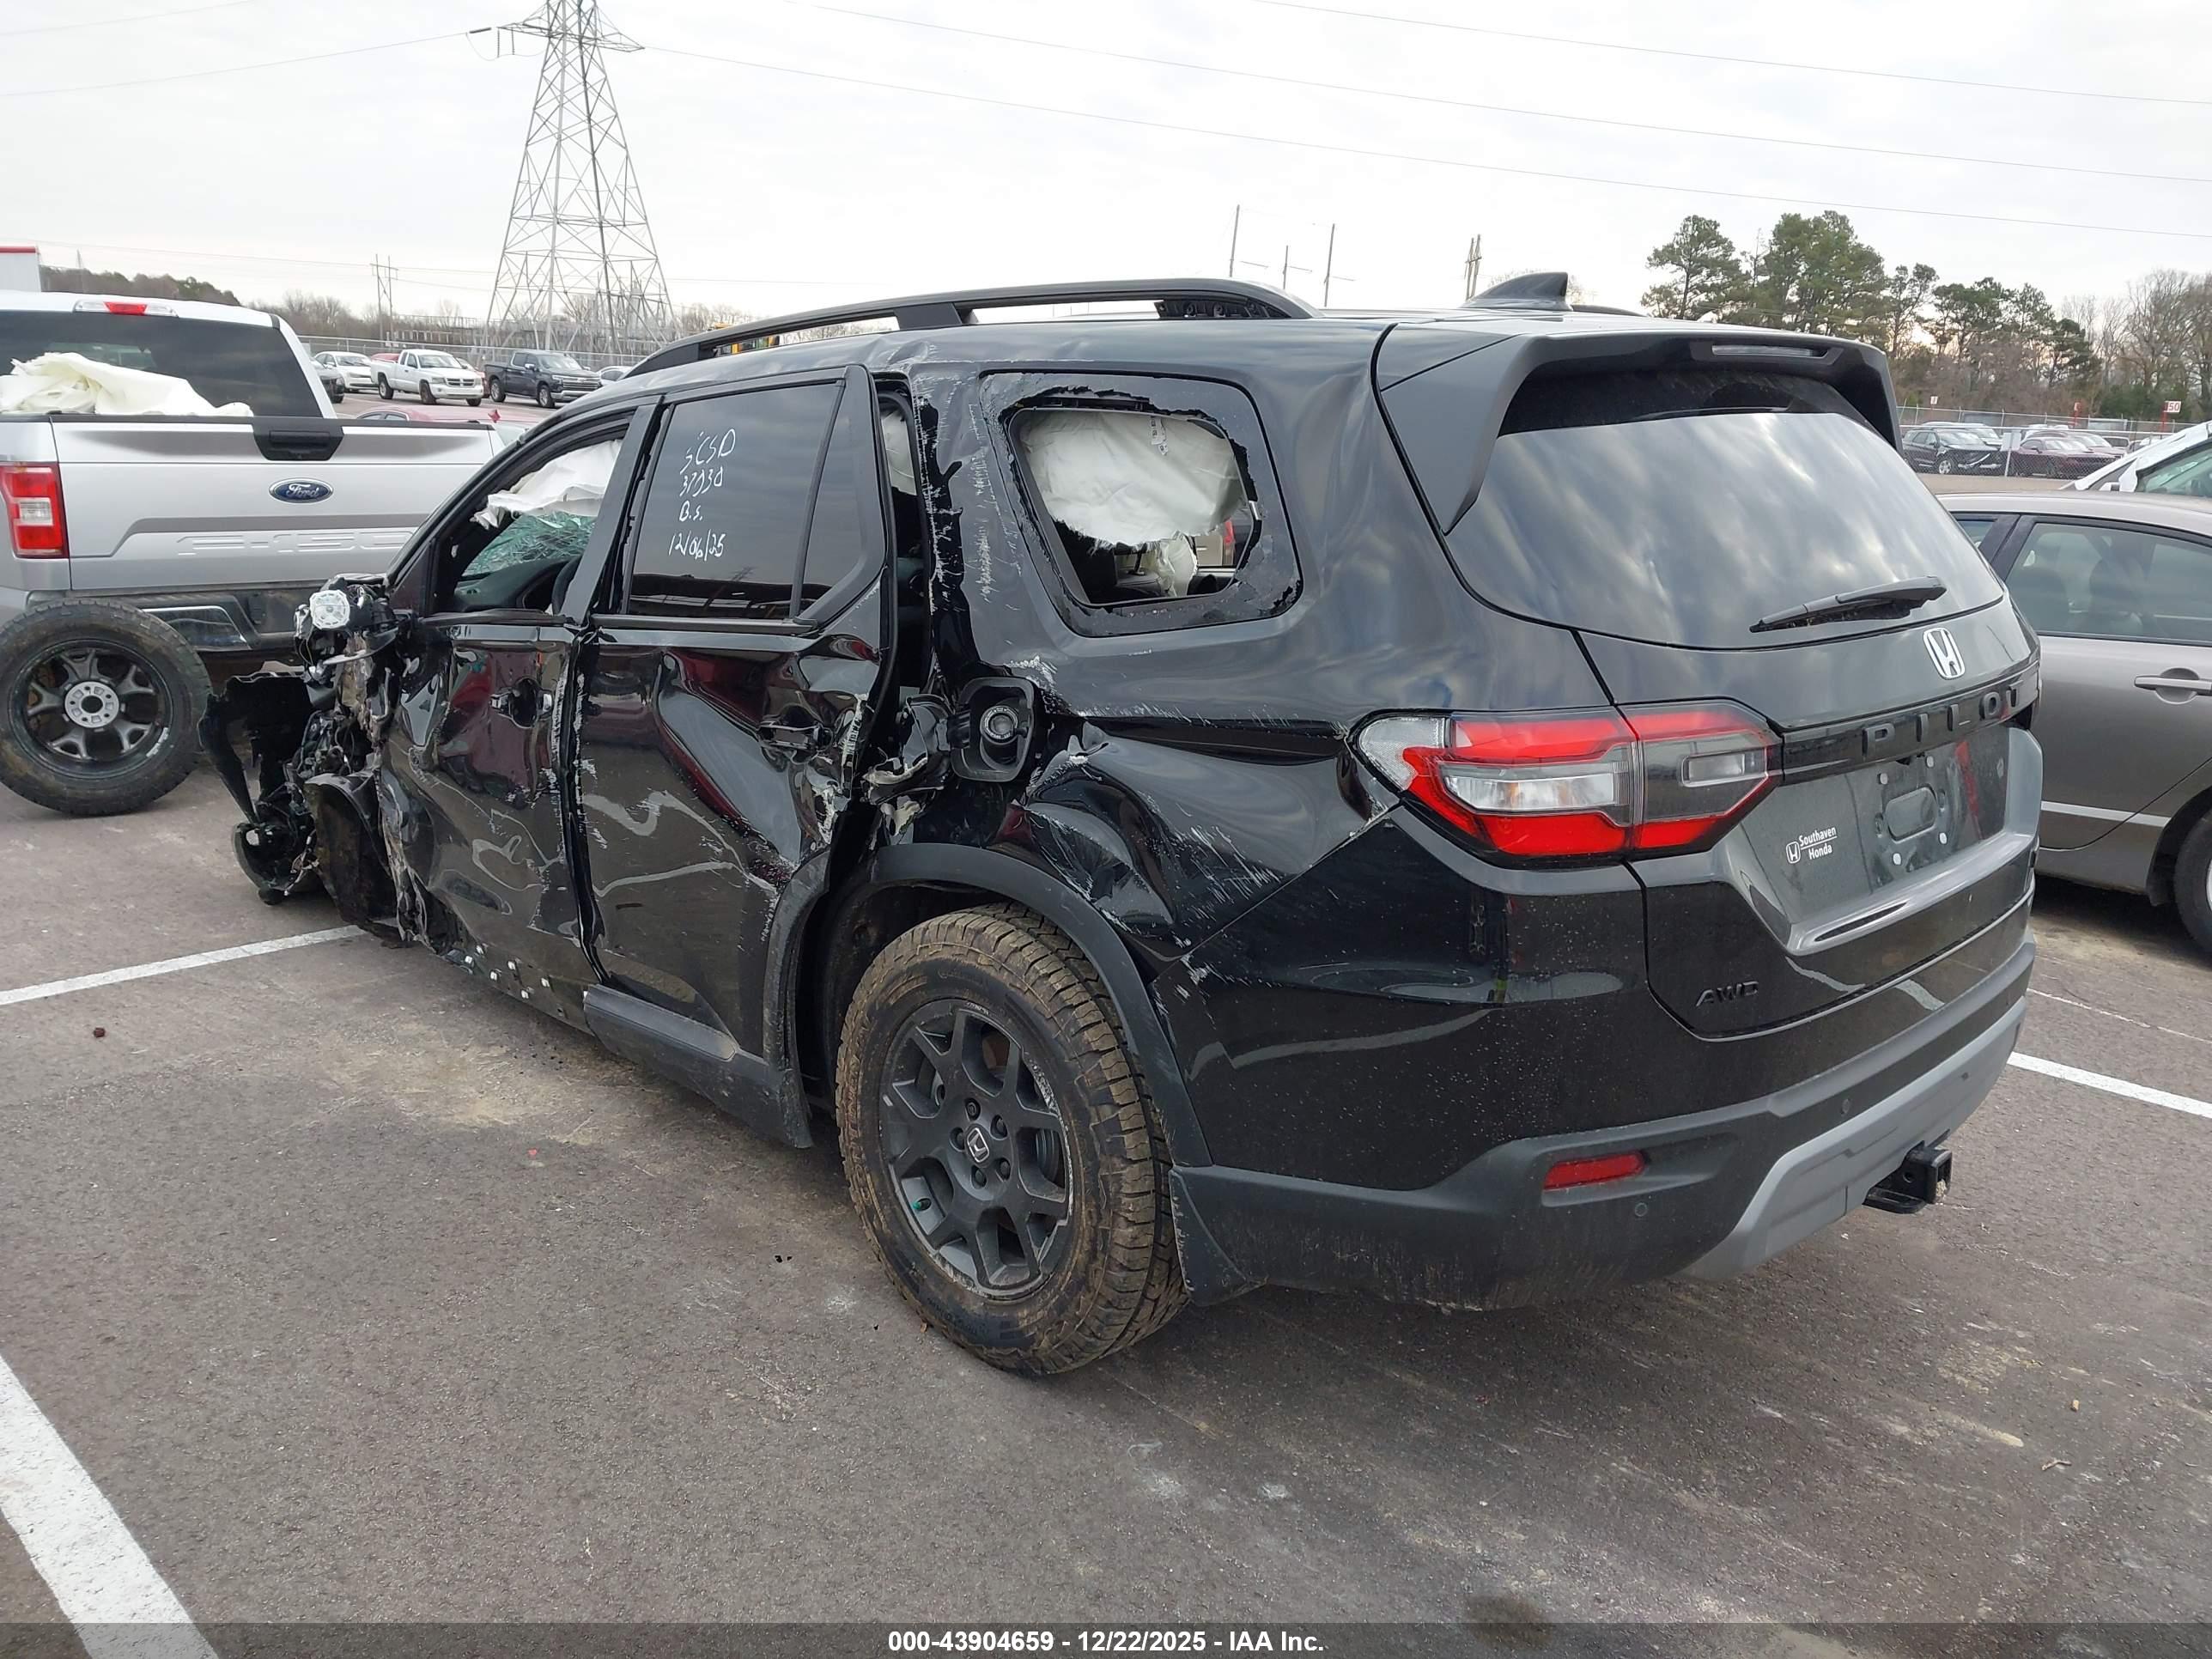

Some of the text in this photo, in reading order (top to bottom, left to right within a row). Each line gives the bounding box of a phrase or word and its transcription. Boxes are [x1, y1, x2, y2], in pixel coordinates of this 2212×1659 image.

[286, 483, 319, 497] Ford
[1862, 679, 2024, 757] PILOT
[1799, 827, 1837, 847] Southaven
[1808, 842, 1832, 860] Honda
[1696, 981, 1759, 1006] AWD
